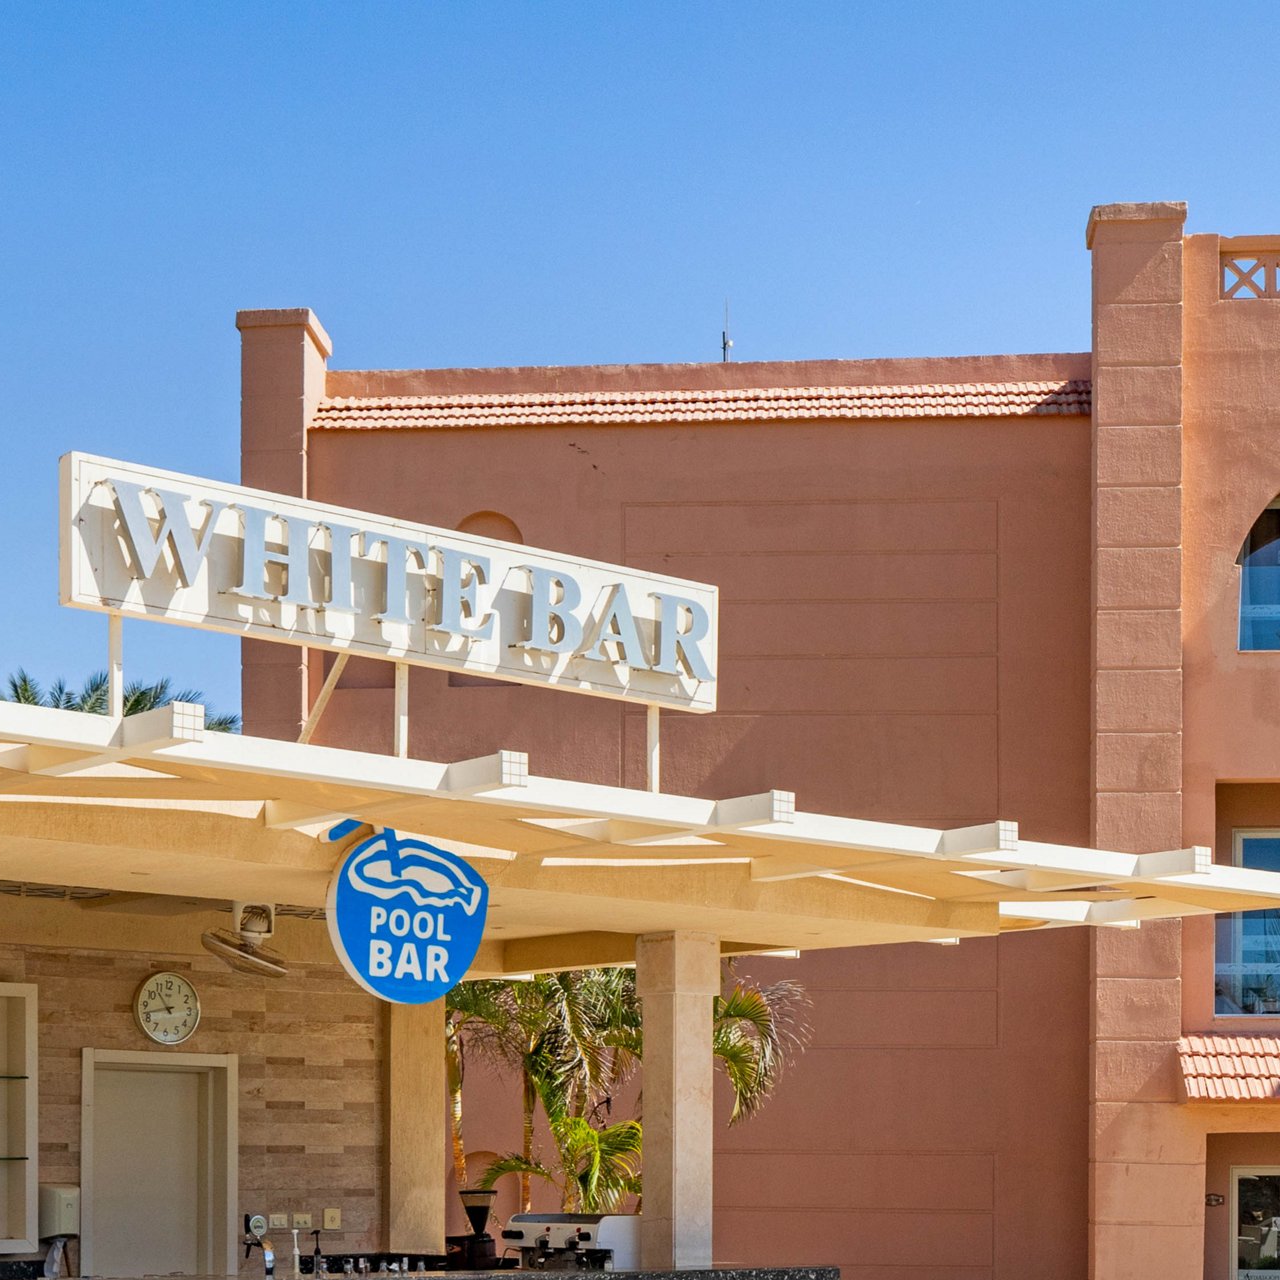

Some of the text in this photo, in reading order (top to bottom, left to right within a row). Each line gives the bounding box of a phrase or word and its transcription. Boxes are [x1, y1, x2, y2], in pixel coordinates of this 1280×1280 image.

[98, 477, 716, 682] WHITE BAR
[370, 906, 451, 941] POOL
[369, 939, 450, 983] BAR
[156, 983, 163, 992] 11
[165, 980, 173, 991] 12
[148, 990, 156, 1000] 10
[184, 994, 189, 1004] 2
[142, 1001, 148, 1010] 9
[186, 1007, 192, 1017] 3
[145, 1013, 151, 1023] 8
[153, 1023, 159, 1032] 7
[181, 1019, 187, 1028] 4
[163, 1029, 168, 1037] 6
[174, 1026, 179, 1036] 5
